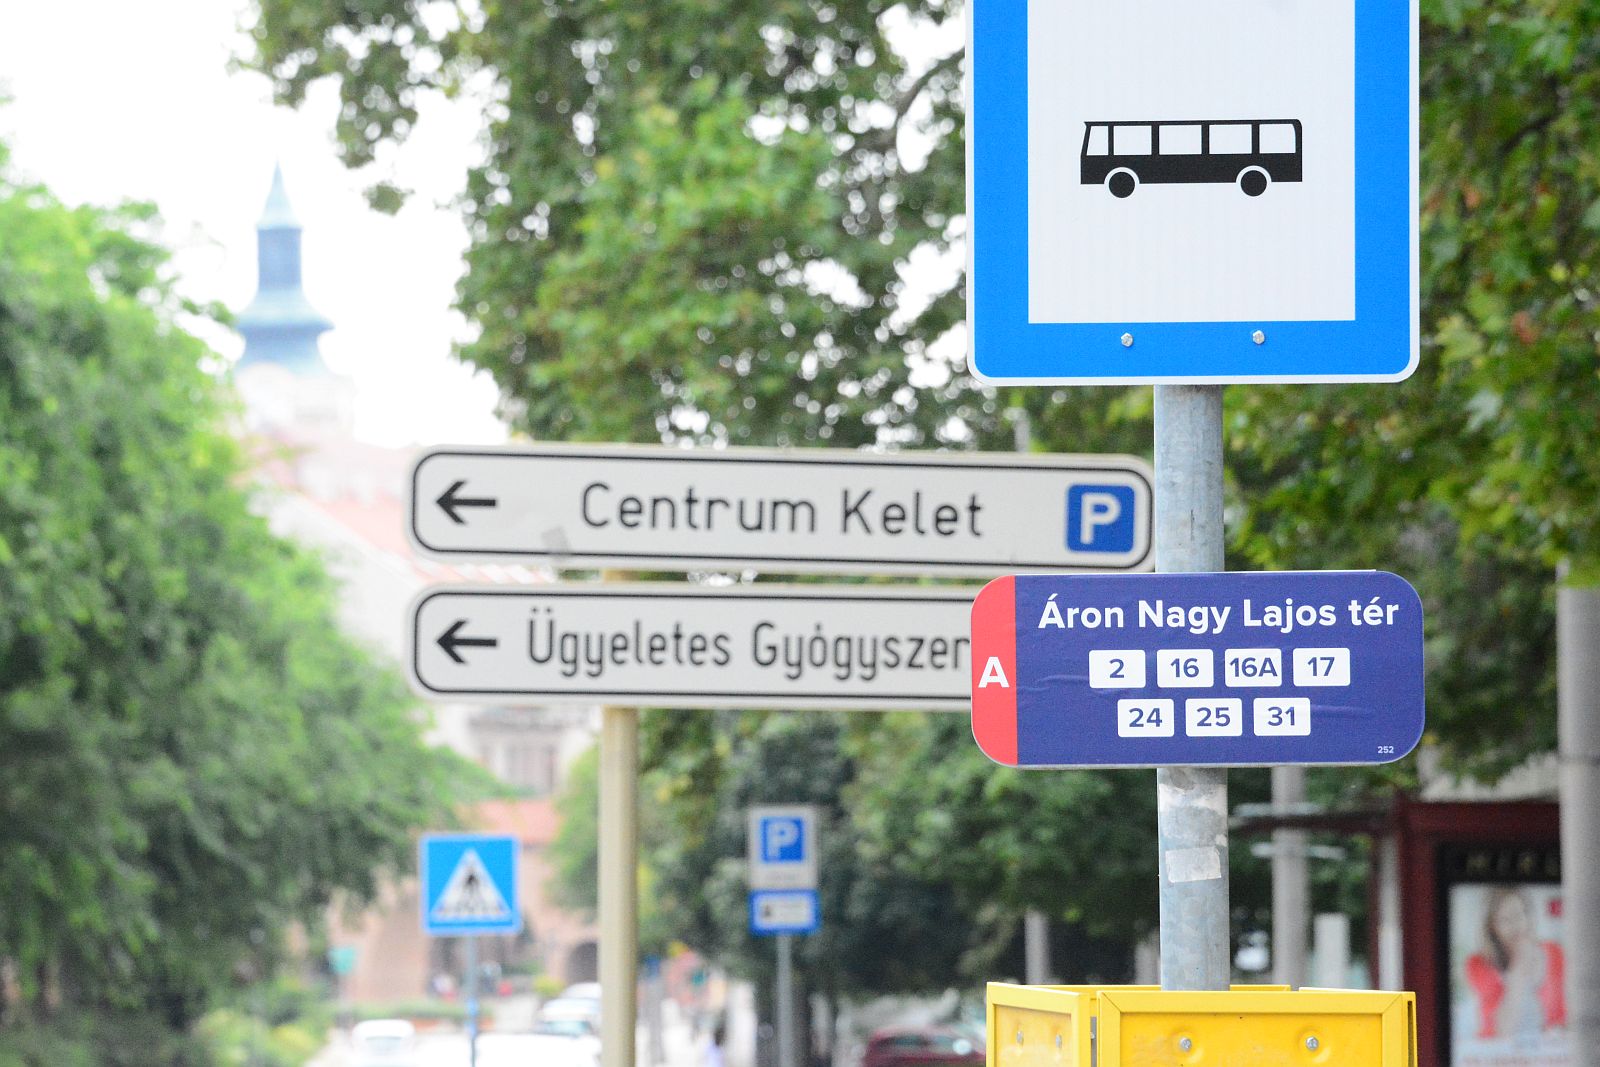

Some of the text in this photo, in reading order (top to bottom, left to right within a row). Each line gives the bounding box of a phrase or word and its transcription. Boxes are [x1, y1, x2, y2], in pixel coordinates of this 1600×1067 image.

[580, 481, 1121, 545] Centrum Kelet P
[1037, 592, 1400, 635] Áron Nagy Lajos tér
[528, 607, 732, 679] Ügyeletes
[978, 656, 1010, 688] A
[1109, 656, 1335, 679] 2 16 16A 17
[1128, 706, 1296, 728] 24 25 31
[1377, 745, 1395, 754] 252
[766, 820, 800, 859] P
